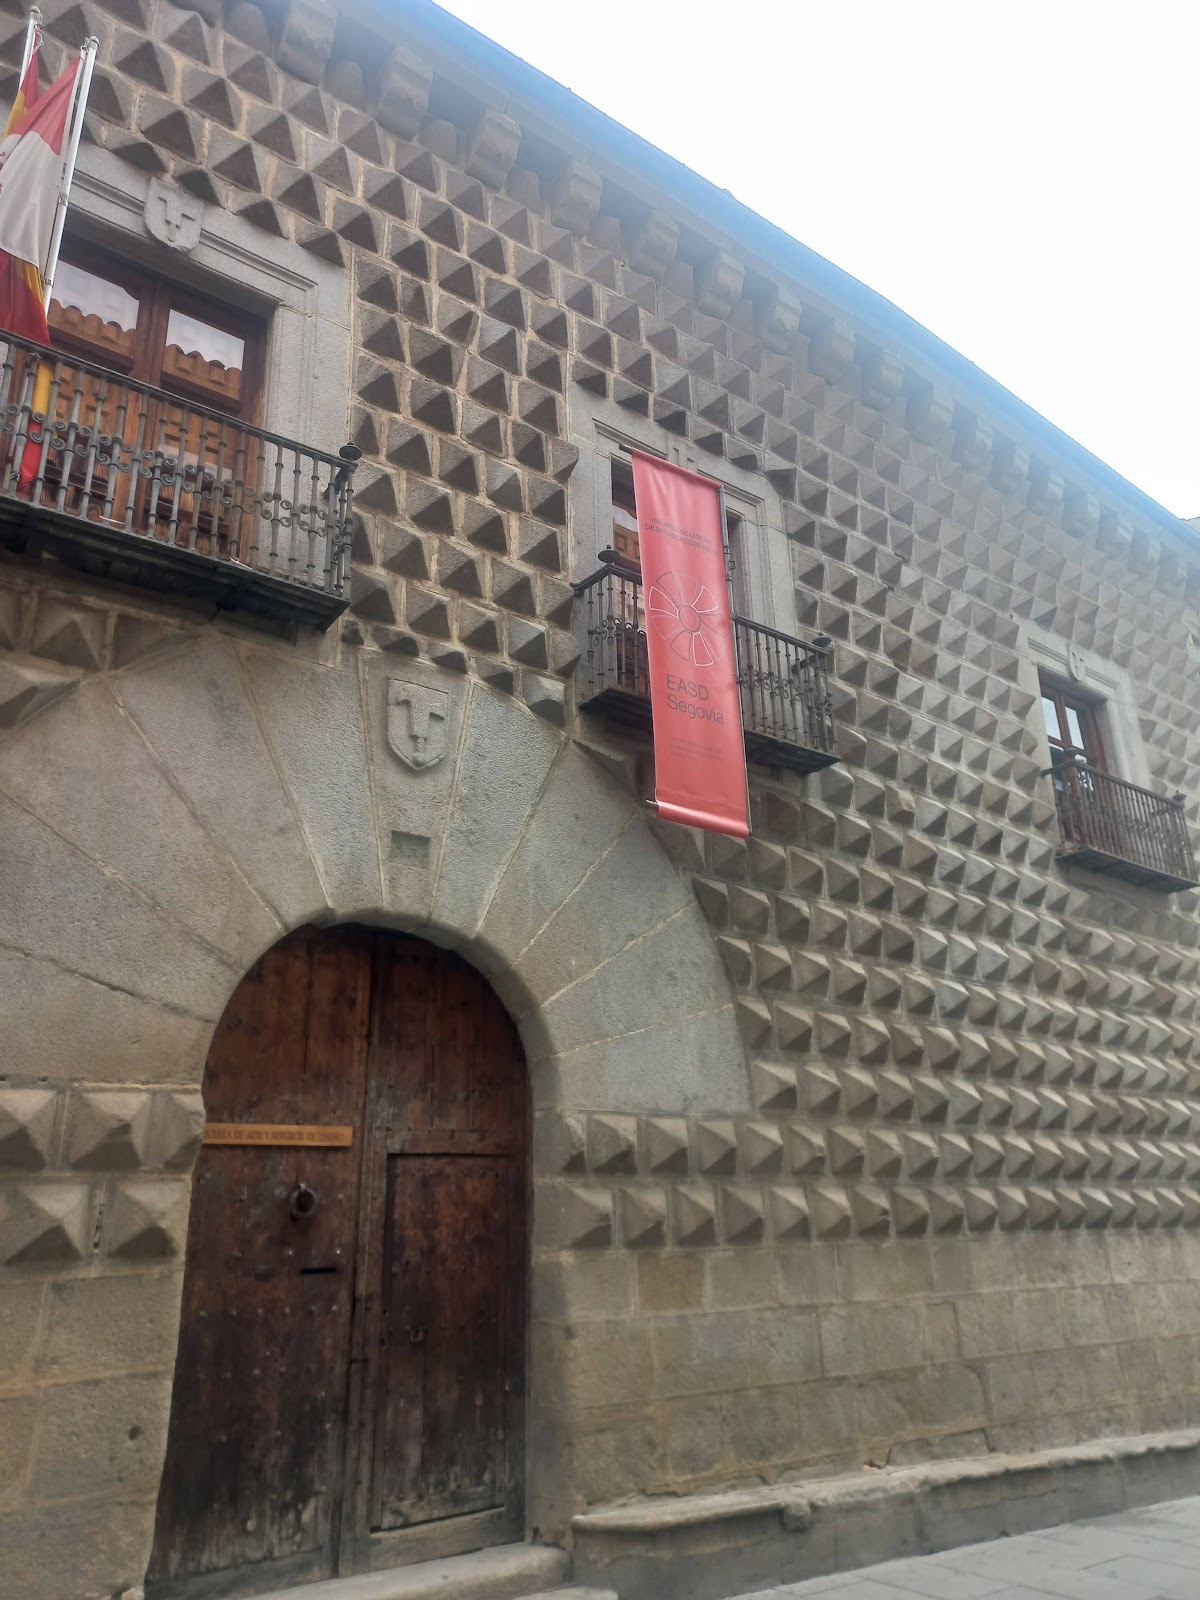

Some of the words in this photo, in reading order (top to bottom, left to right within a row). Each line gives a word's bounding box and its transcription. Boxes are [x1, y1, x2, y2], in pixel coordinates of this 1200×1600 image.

[651, 517, 662, 526] 100
[646, 523, 655, 532] DE
[666, 673, 709, 701] EASD
[668, 693, 725, 725] Segovia
[204, 1129, 232, 1140] SCUELA
